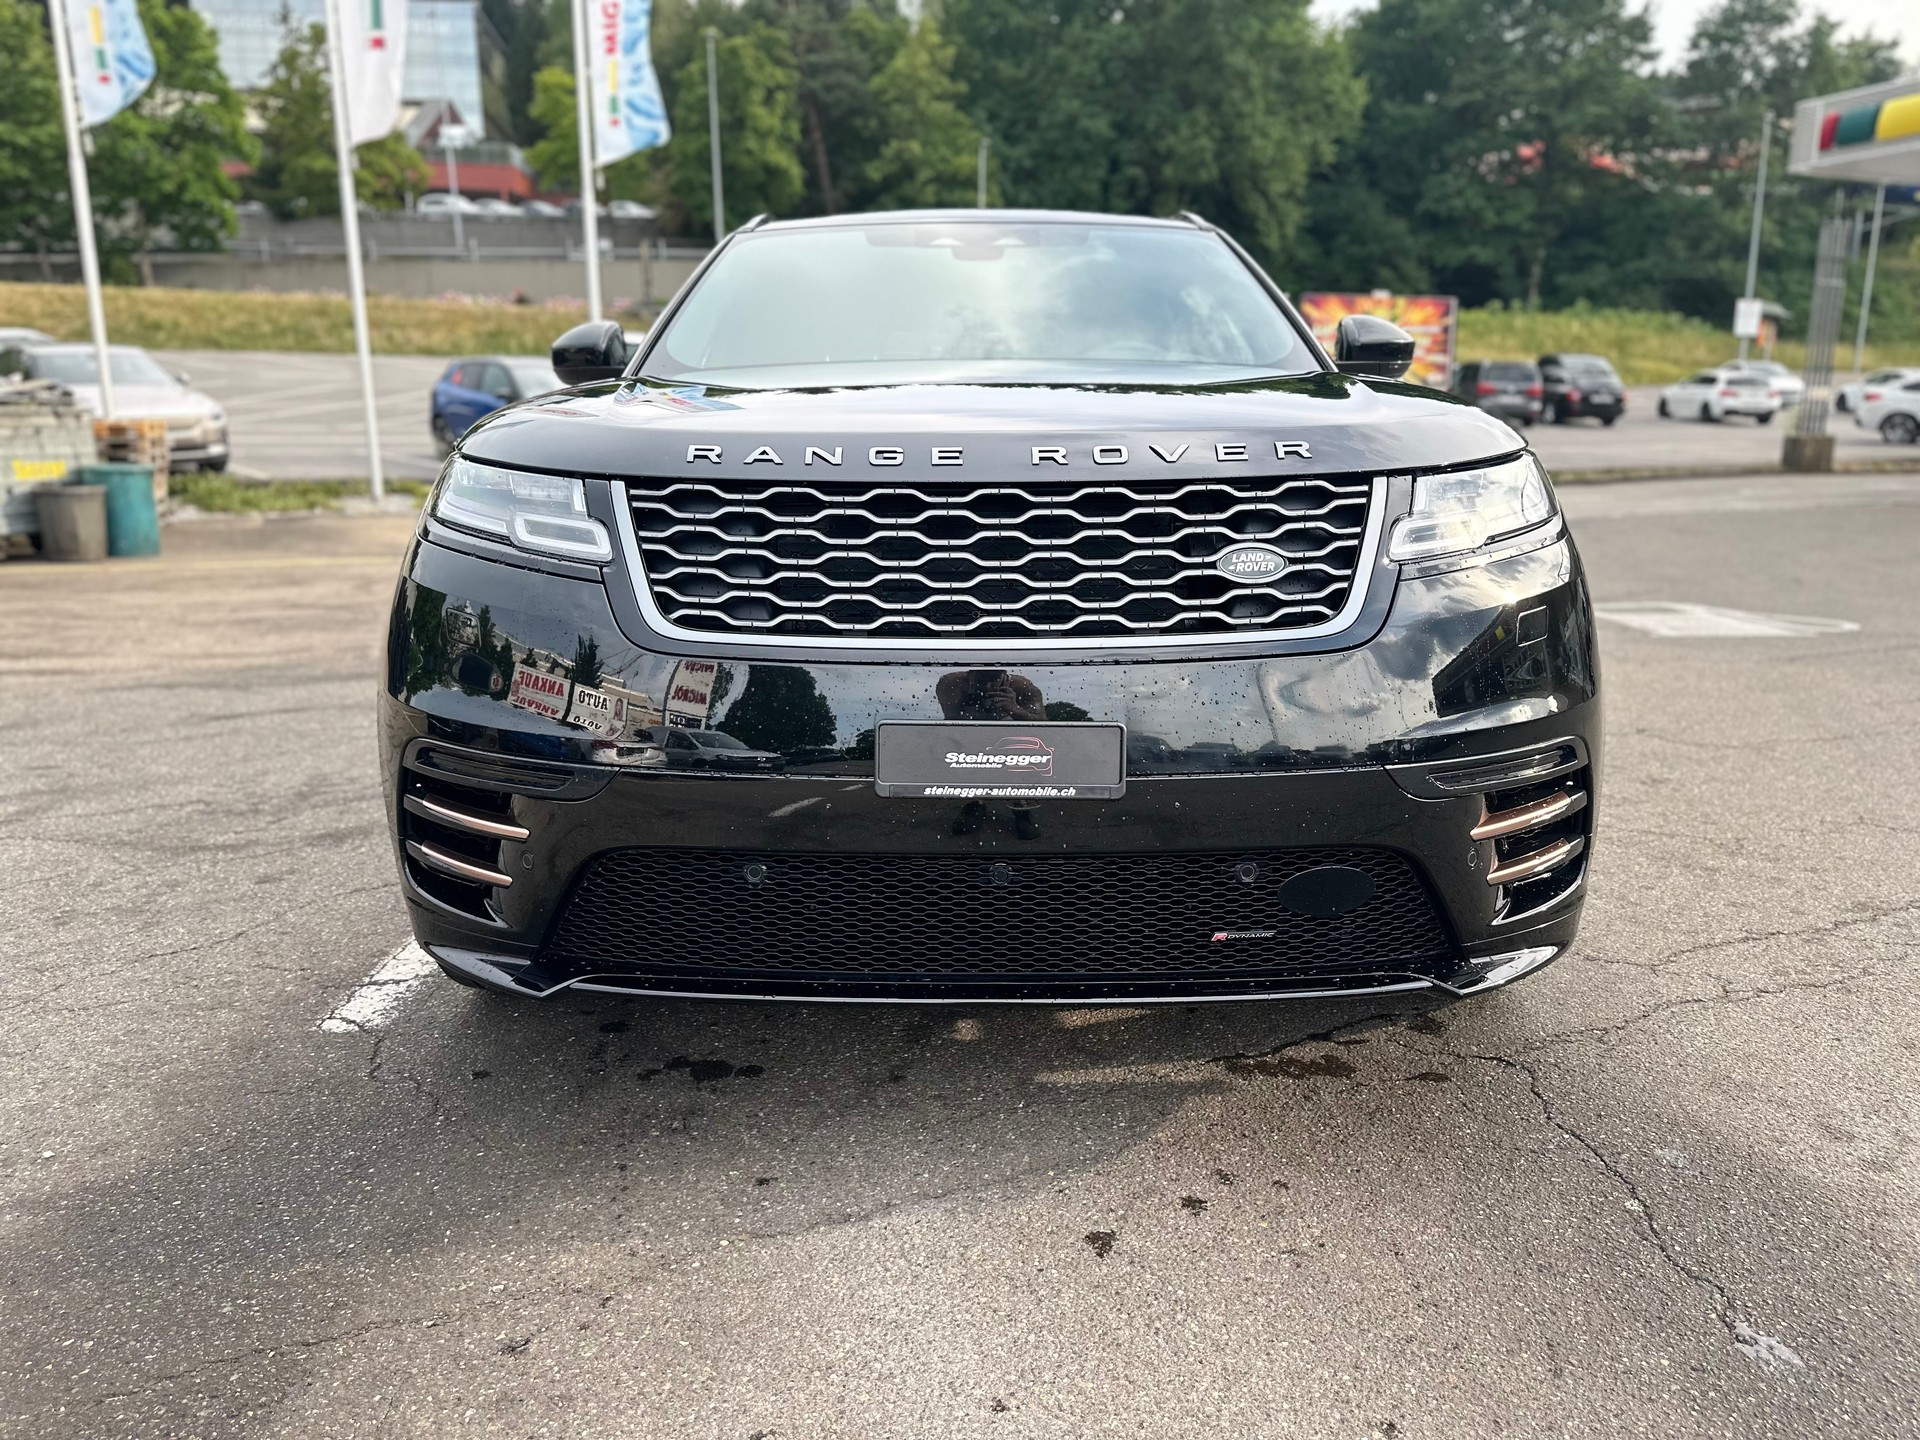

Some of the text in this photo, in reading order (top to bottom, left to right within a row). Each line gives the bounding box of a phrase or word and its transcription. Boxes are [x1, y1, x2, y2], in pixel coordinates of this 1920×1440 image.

[686, 440, 1313, 466] RANGE ROVER
[1231, 553, 1264, 563] LAND
[1236, 562, 1276, 572] ROVER
[945, 752, 1051, 766] Steinegger
[924, 785, 1077, 797] steinegger-automobile.ch
